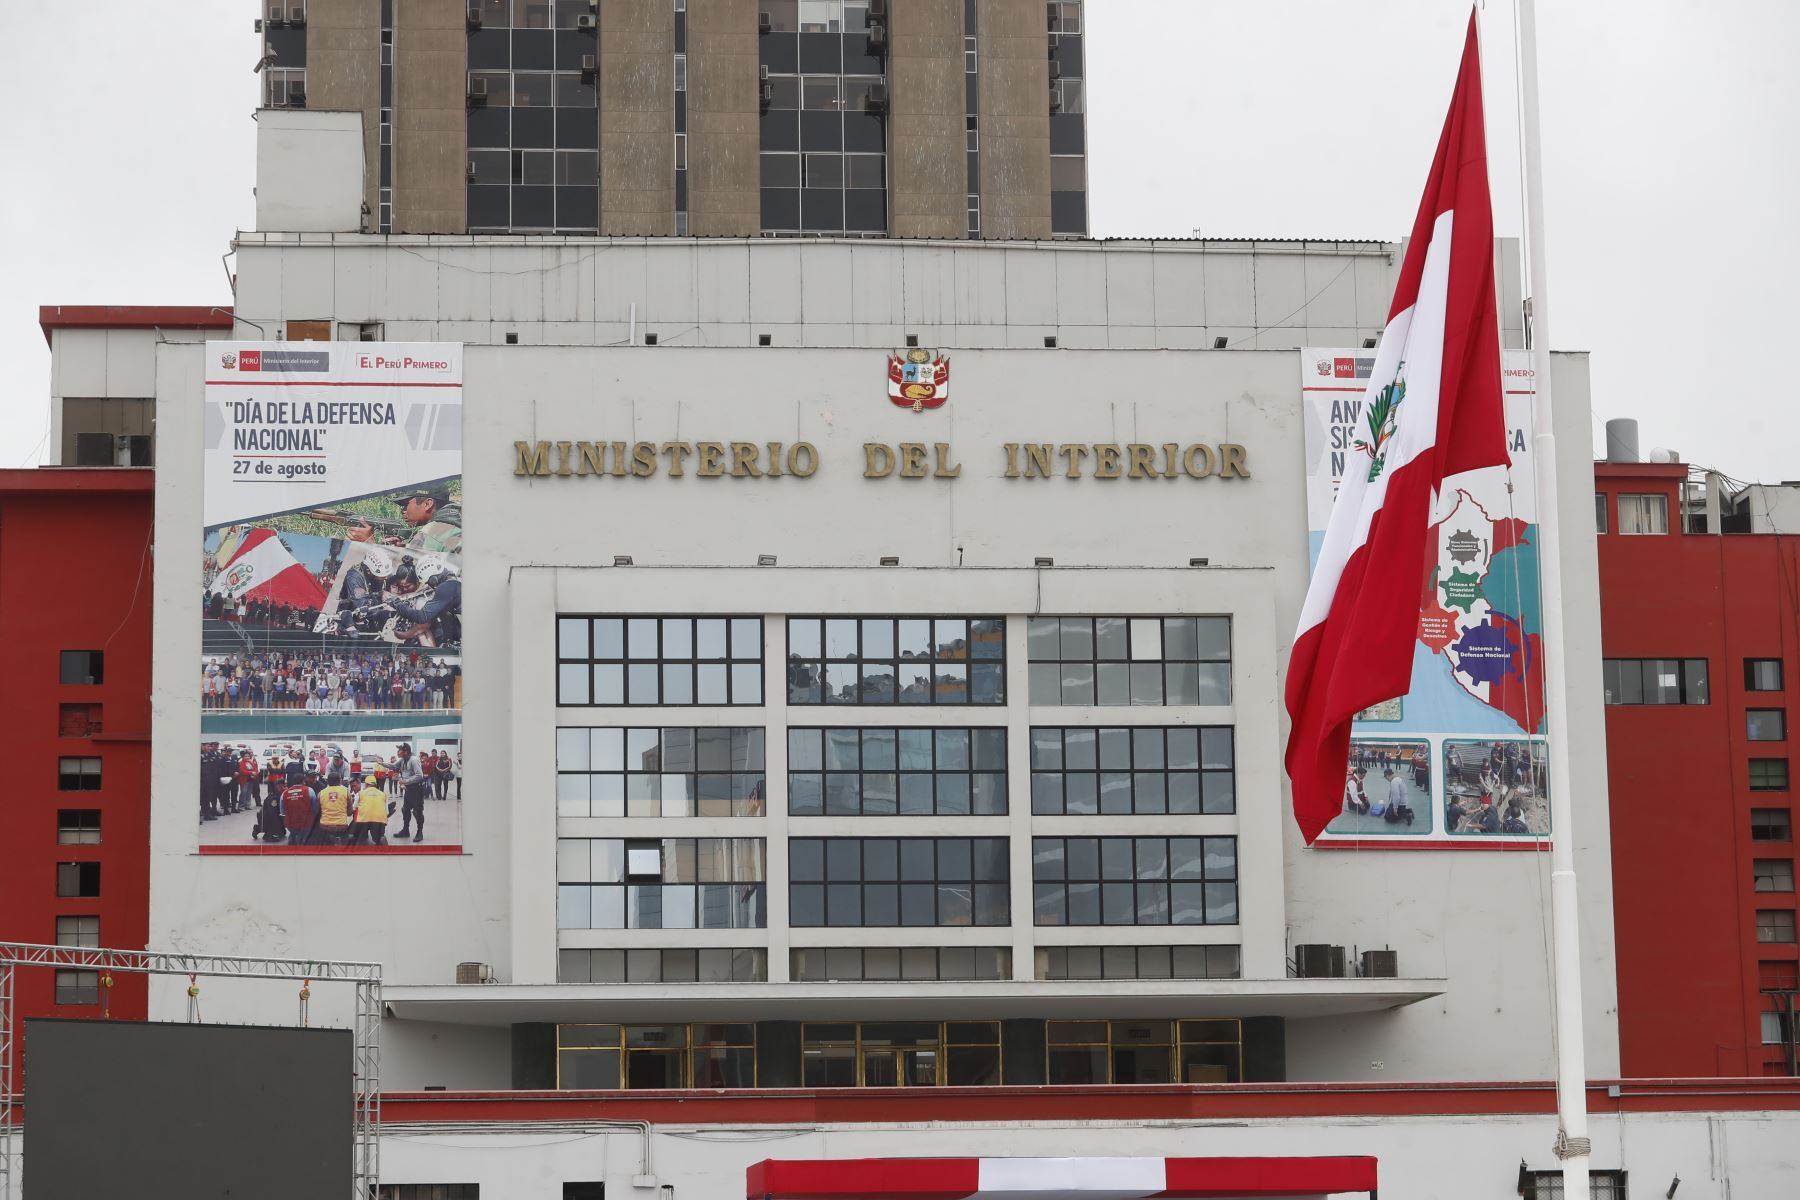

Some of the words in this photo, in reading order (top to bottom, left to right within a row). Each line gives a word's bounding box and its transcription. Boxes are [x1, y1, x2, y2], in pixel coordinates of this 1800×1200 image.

[240, 356, 259, 365] PERÚ
[360, 356, 374, 369] EL
[375, 356, 402, 369] PERÚ
[403, 357, 448, 369] PRIMERO
[225, 397, 263, 424] "DÍA
[266, 402, 289, 424] DE
[291, 402, 314, 424] LA
[317, 402, 396, 425] DEFENSA
[234, 428, 328, 451] NACIONAL"
[233, 460, 251, 475] 27
[255, 460, 273, 475] de
[277, 462, 327, 479] agosto
[513, 440, 820, 478] MINISTERIO
[862, 442, 962, 479] DEL
[1003, 442, 1251, 479] INTERIOR
